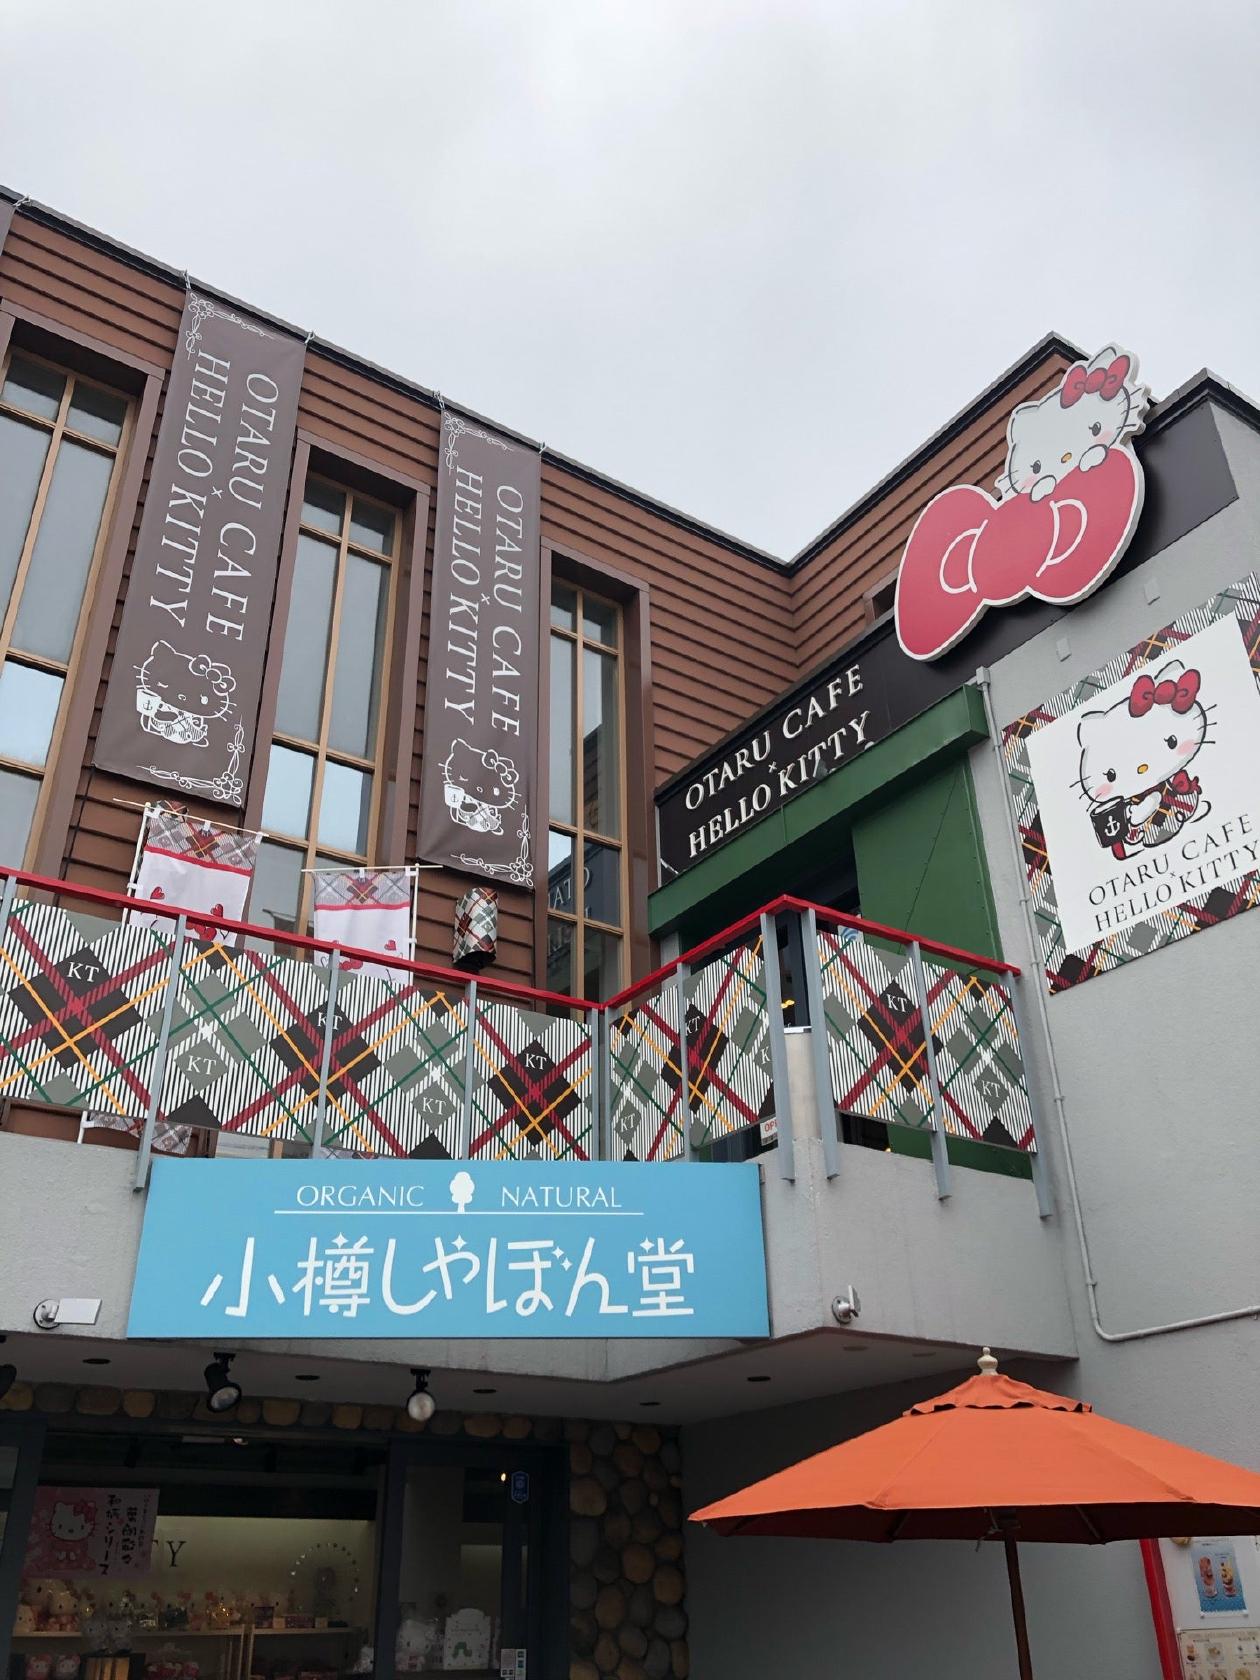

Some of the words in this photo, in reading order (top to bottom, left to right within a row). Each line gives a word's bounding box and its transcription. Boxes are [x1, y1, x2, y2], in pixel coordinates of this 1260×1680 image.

[177, 348, 231, 477] HELLO
[228, 373, 279, 509] OTARU
[150, 483, 207, 628] KITTY
[451, 465, 483, 586] HELLO
[493, 485, 524, 613] OTARU
[206, 522, 256, 641] CAFE
[444, 592, 479, 725] KITTY
[491, 625, 522, 736] CAFE
[685, 731, 771, 810] OTARU
[782, 664, 864, 739] CAFE
[689, 784, 772, 858] HELLO
[778, 710, 870, 796] KITTY
[1089, 854, 1169, 906] OTARU
[1182, 813, 1253, 860] CAFE
[1095, 883, 1172, 932] HELLO
[1179, 839, 1260, 893] KITTY
[66, 961, 100, 983] KT
[886, 994, 908, 1013] KT
[186, 1055, 217, 1076] KT
[525, 1052, 547, 1070] KT
[760, 1048, 771, 1065] K
[982, 1081, 1001, 1098] KT
[421, 1096, 447, 1116] KT
[620, 1112, 636, 1132] KT
[296, 1185, 424, 1208] ORGANIC
[501, 1185, 622, 1208] NATURAL
